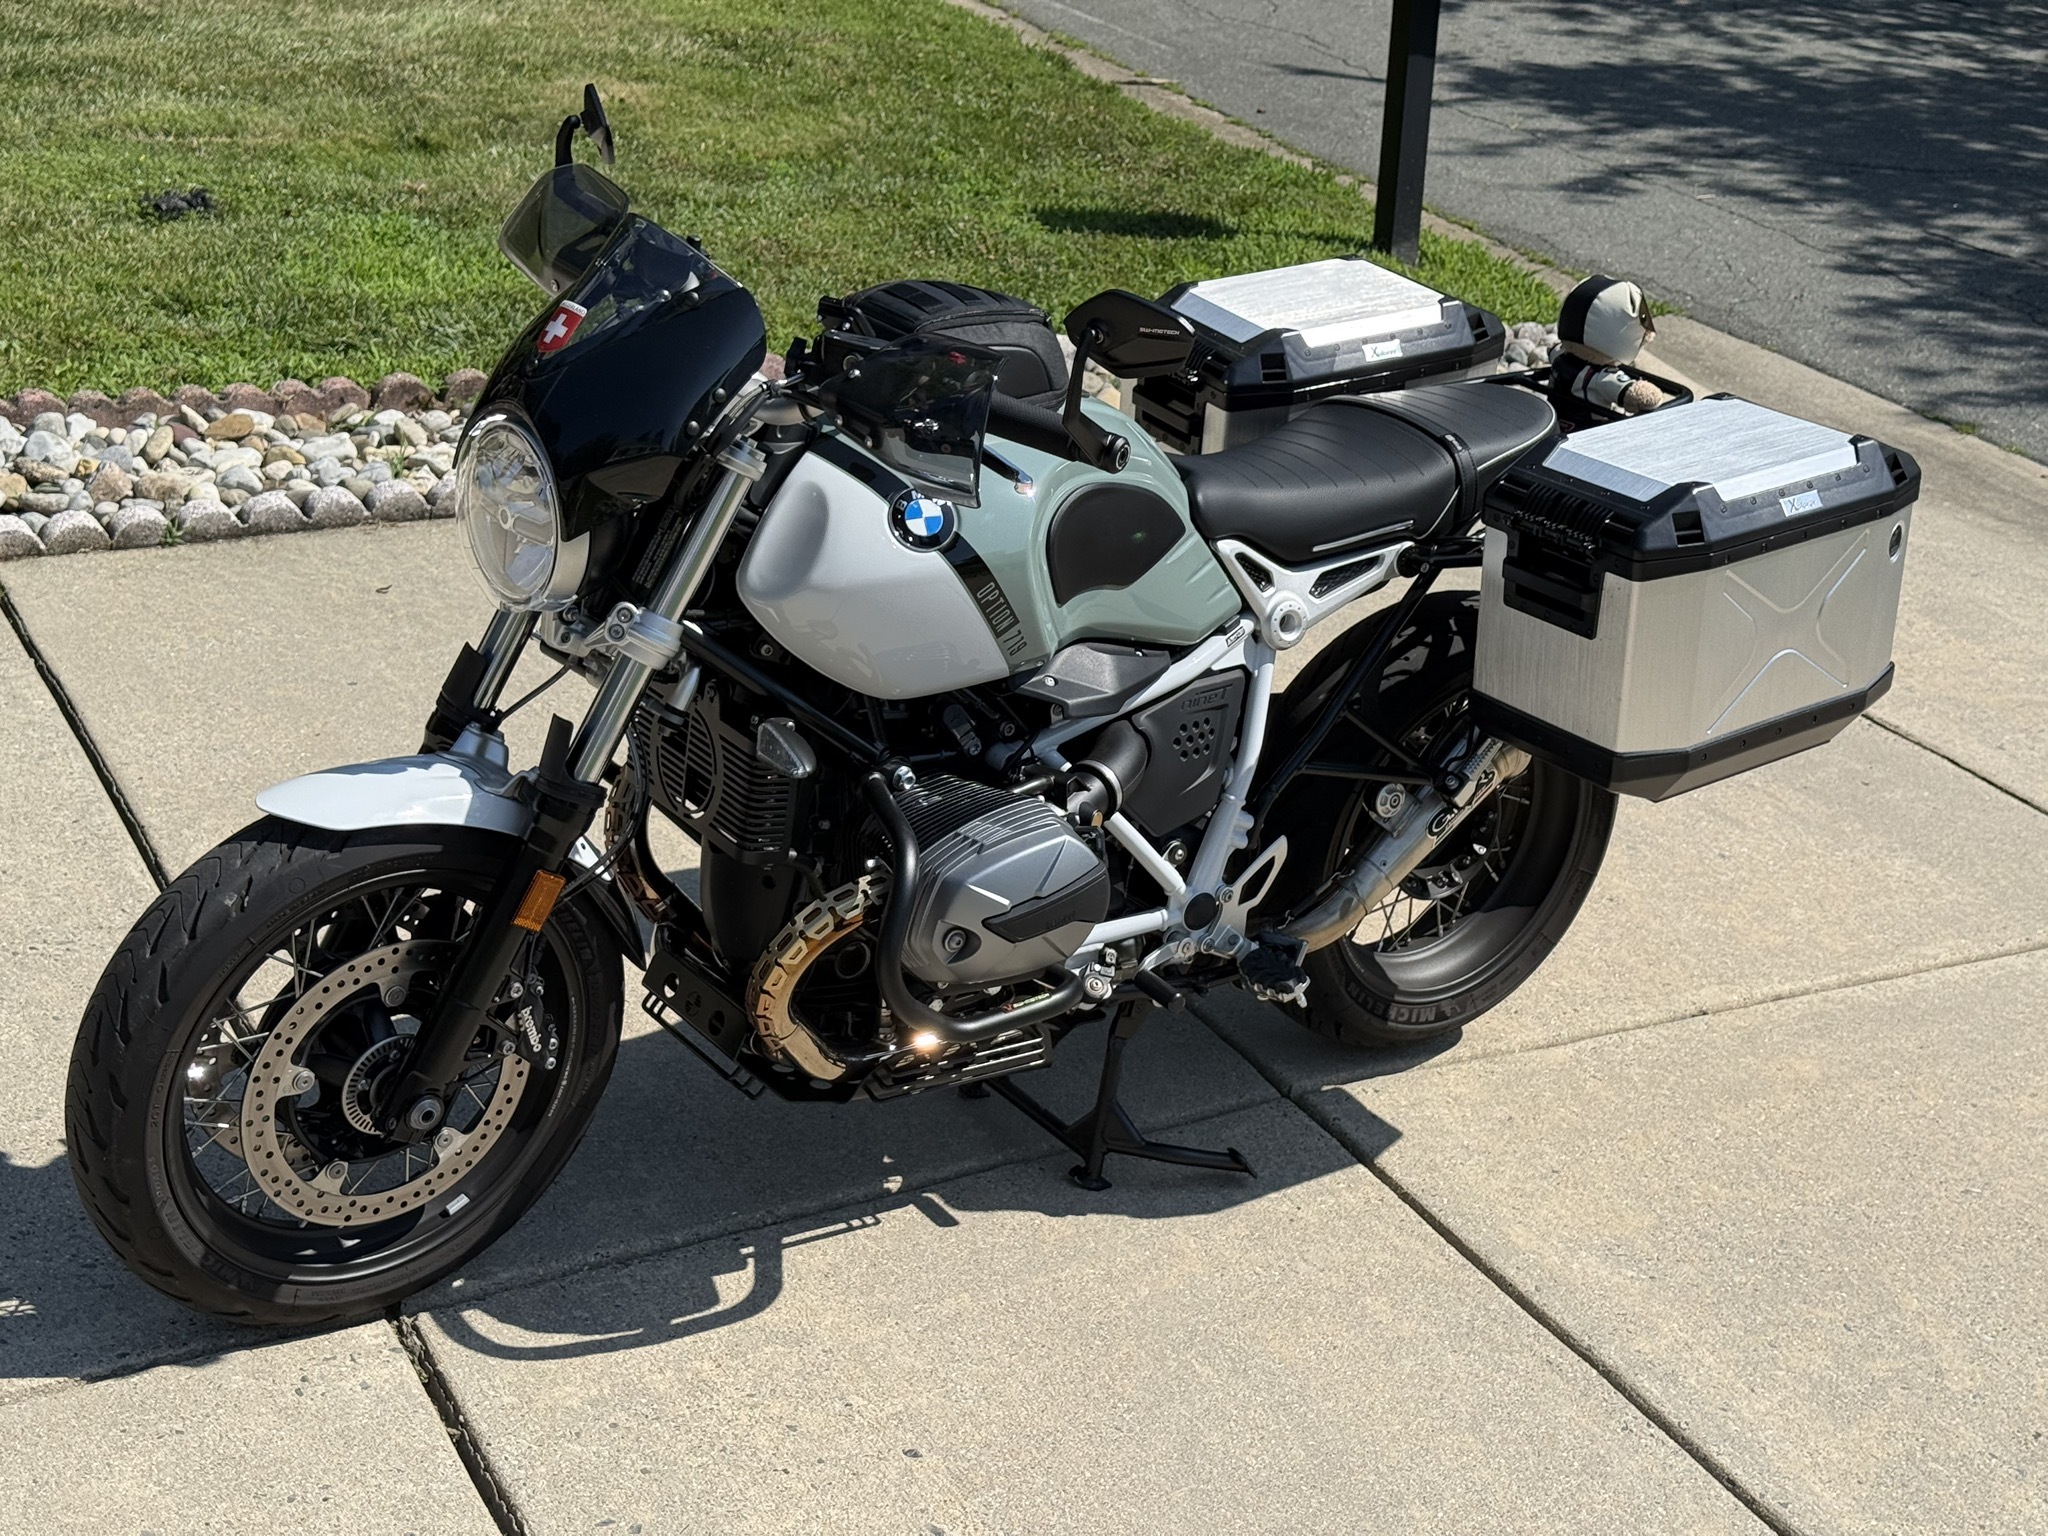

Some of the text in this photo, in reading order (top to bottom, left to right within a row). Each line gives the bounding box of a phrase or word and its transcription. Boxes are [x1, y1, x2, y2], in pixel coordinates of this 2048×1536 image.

[977, 581, 1027, 656] OPTION 719
[521, 1005, 541, 1053] brembo
